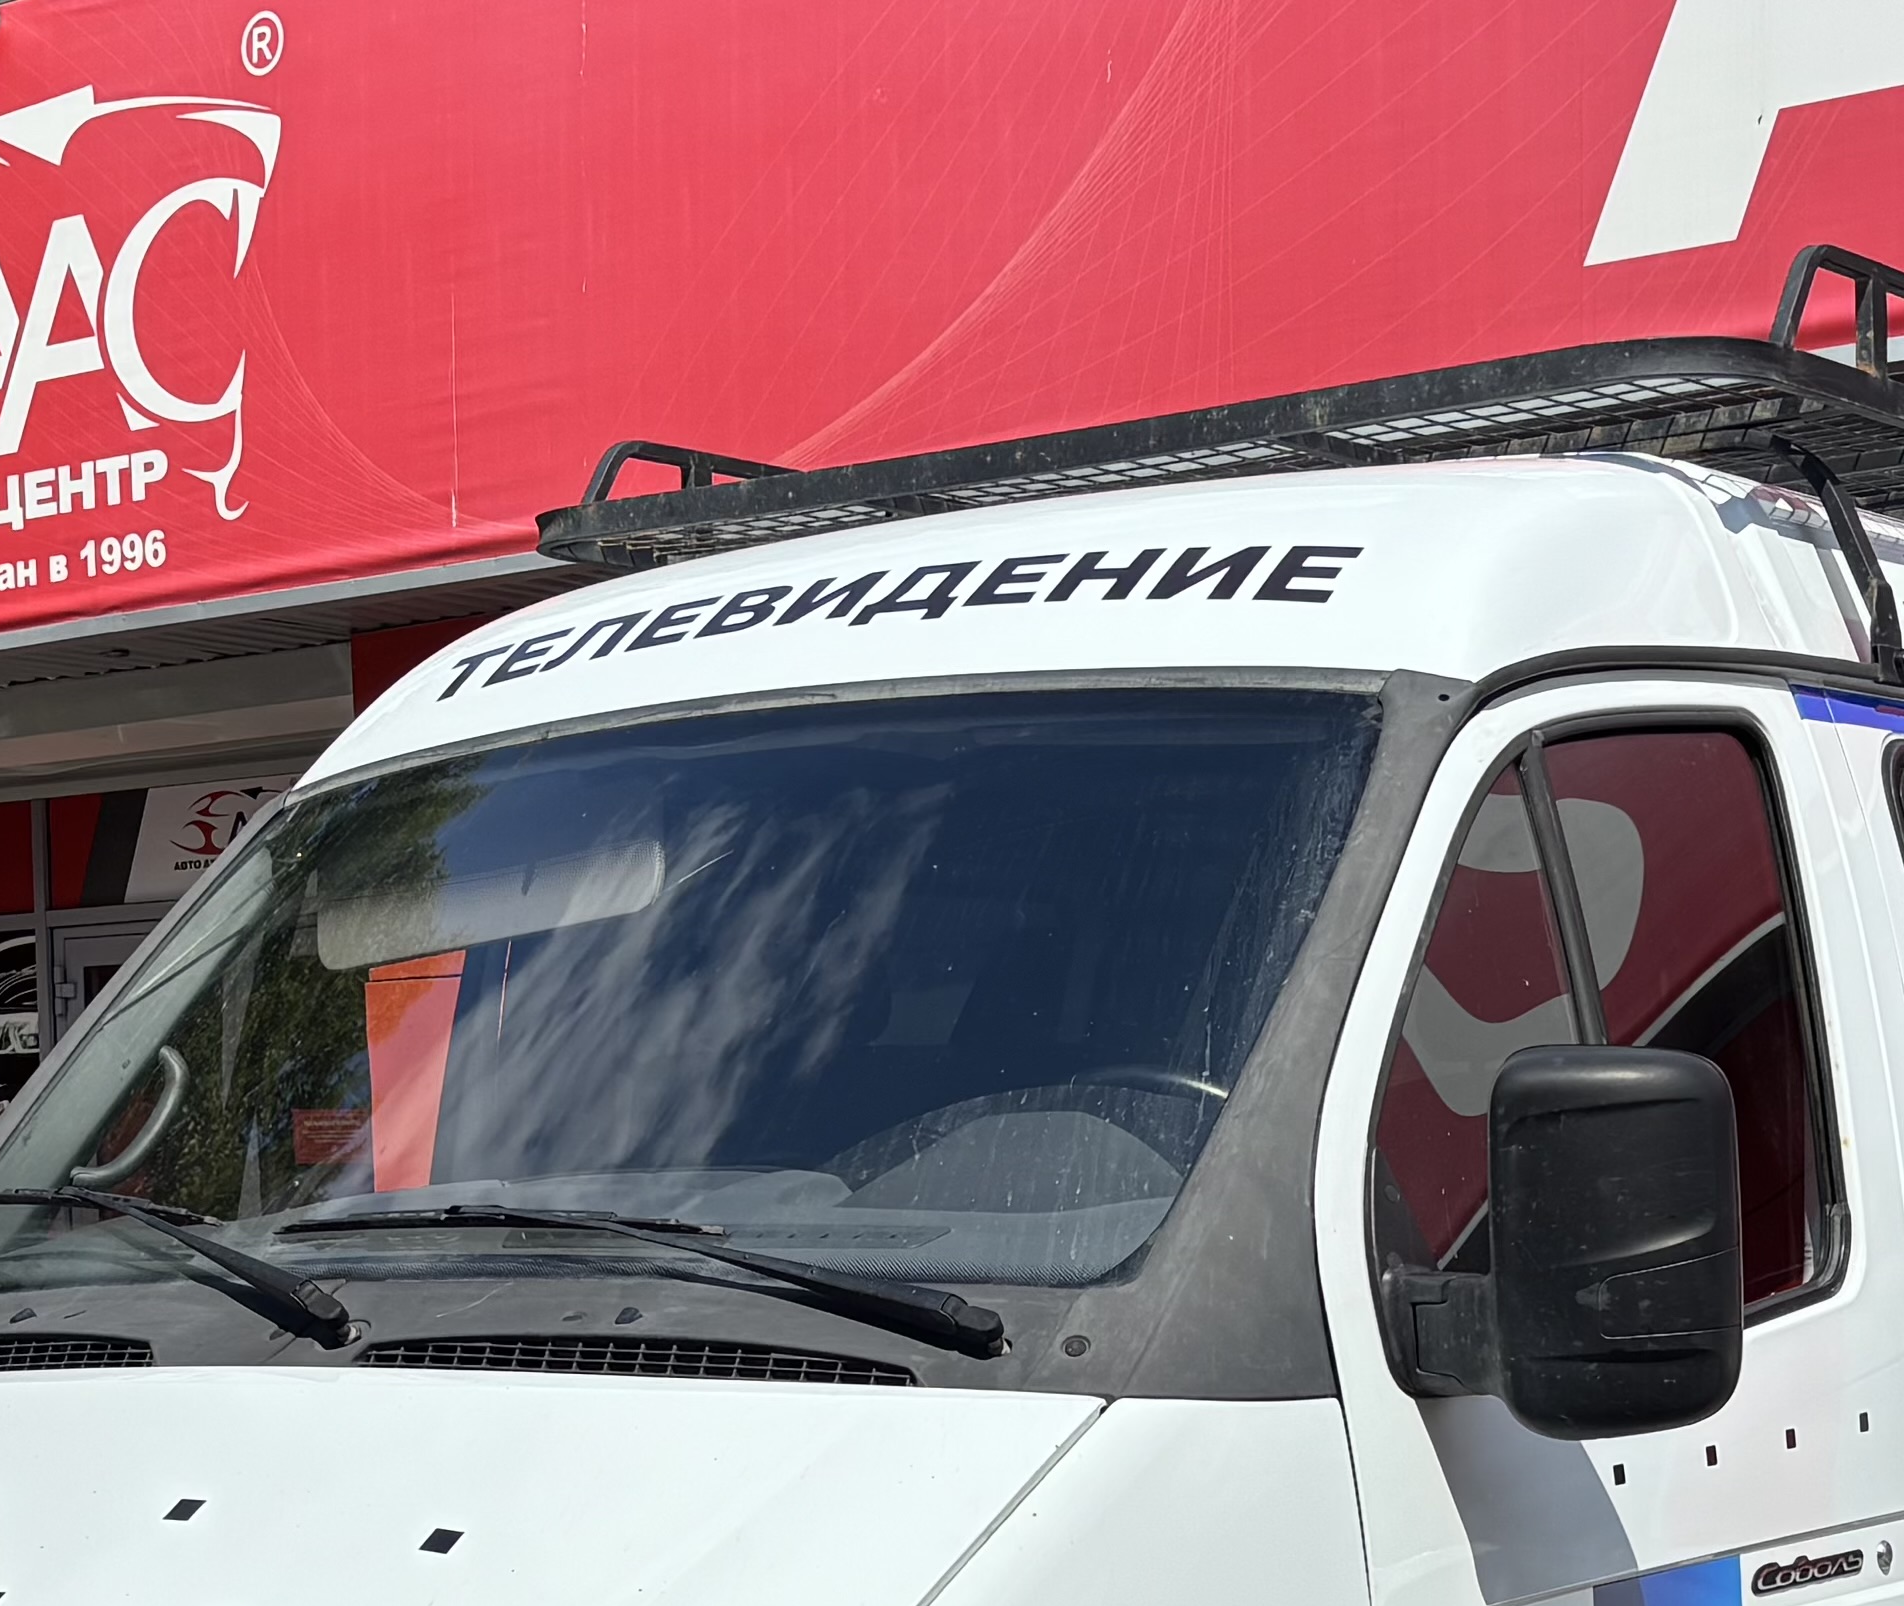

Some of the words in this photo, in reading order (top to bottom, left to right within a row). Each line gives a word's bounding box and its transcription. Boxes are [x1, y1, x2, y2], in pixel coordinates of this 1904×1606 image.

[49, 553, 69, 583] в
[80, 529, 167, 577] 1996
[437, 545, 1364, 702] ТЕЛЕВИДЕНИЕ
[1757, 1553, 1863, 1591] Соболь
